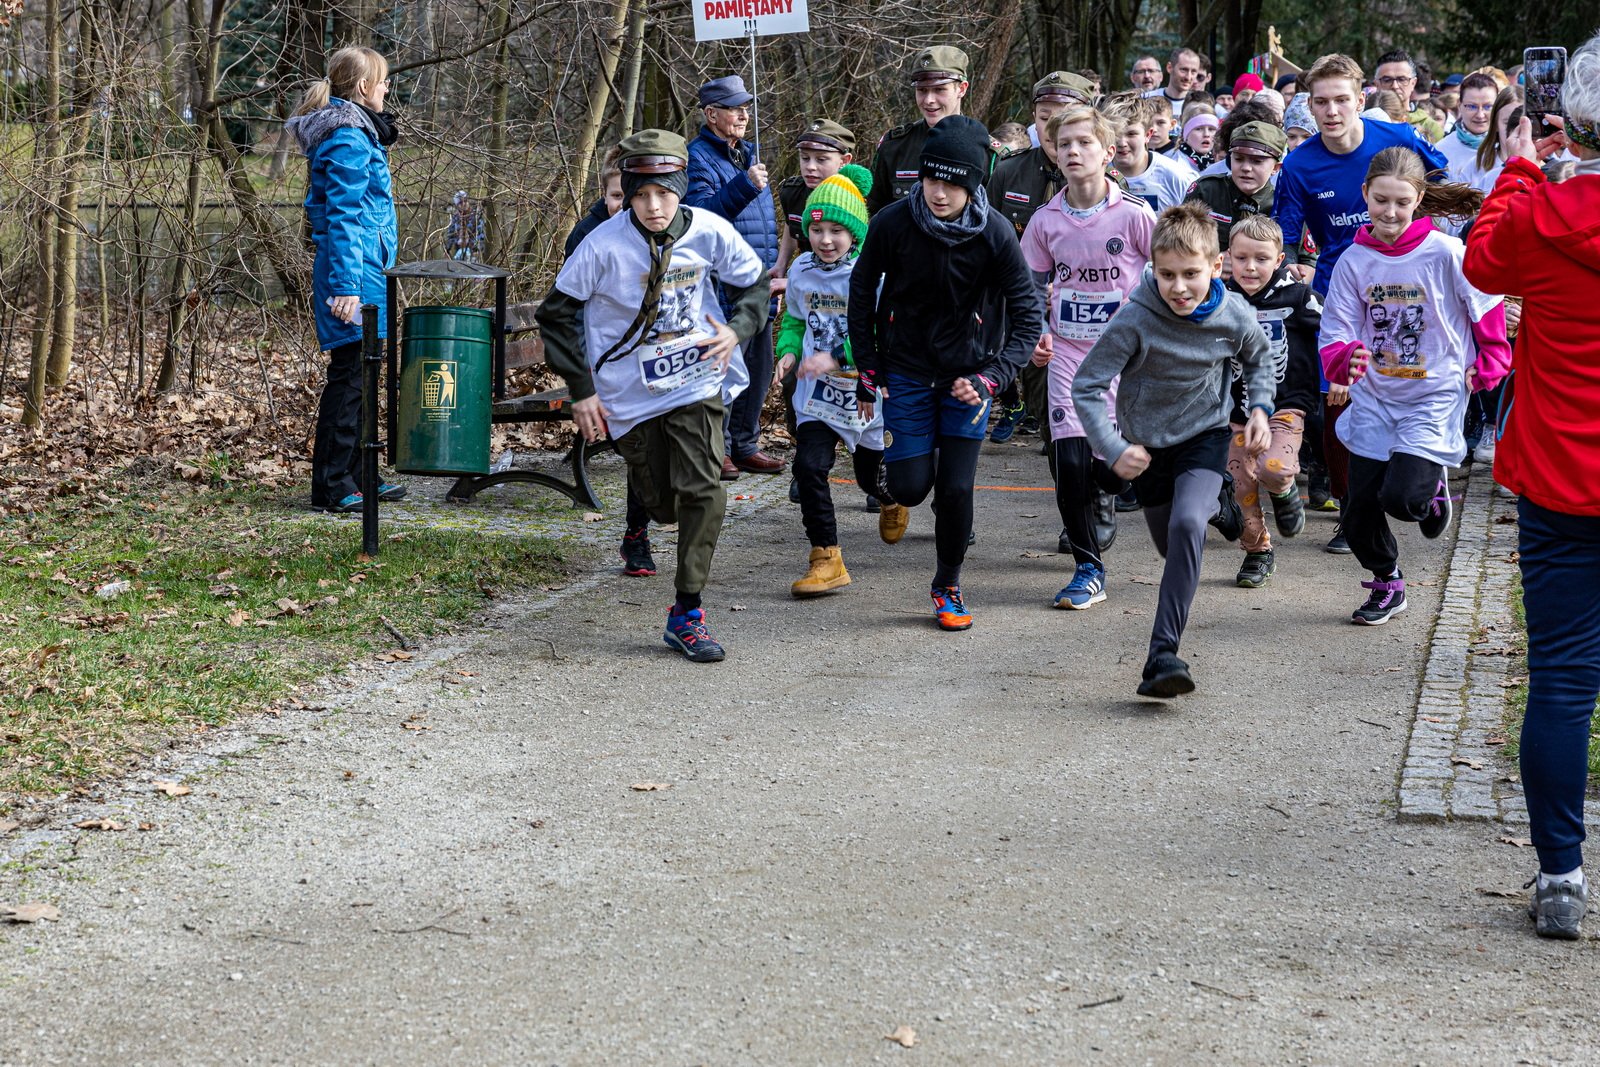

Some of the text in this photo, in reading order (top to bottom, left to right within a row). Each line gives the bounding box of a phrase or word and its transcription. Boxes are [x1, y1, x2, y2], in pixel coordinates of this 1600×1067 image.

[704, 0, 794, 20] PAMIĘTAMY
[935, 163, 968, 176] POWERFUL
[1317, 190, 1335, 199] JAKO
[1077, 266, 1120, 283] XBTO
[1387, 289, 1418, 299] WILCZYM
[1069, 303, 1109, 323] 154
[653, 347, 700, 377] 050
[822, 385, 857, 411] 092
